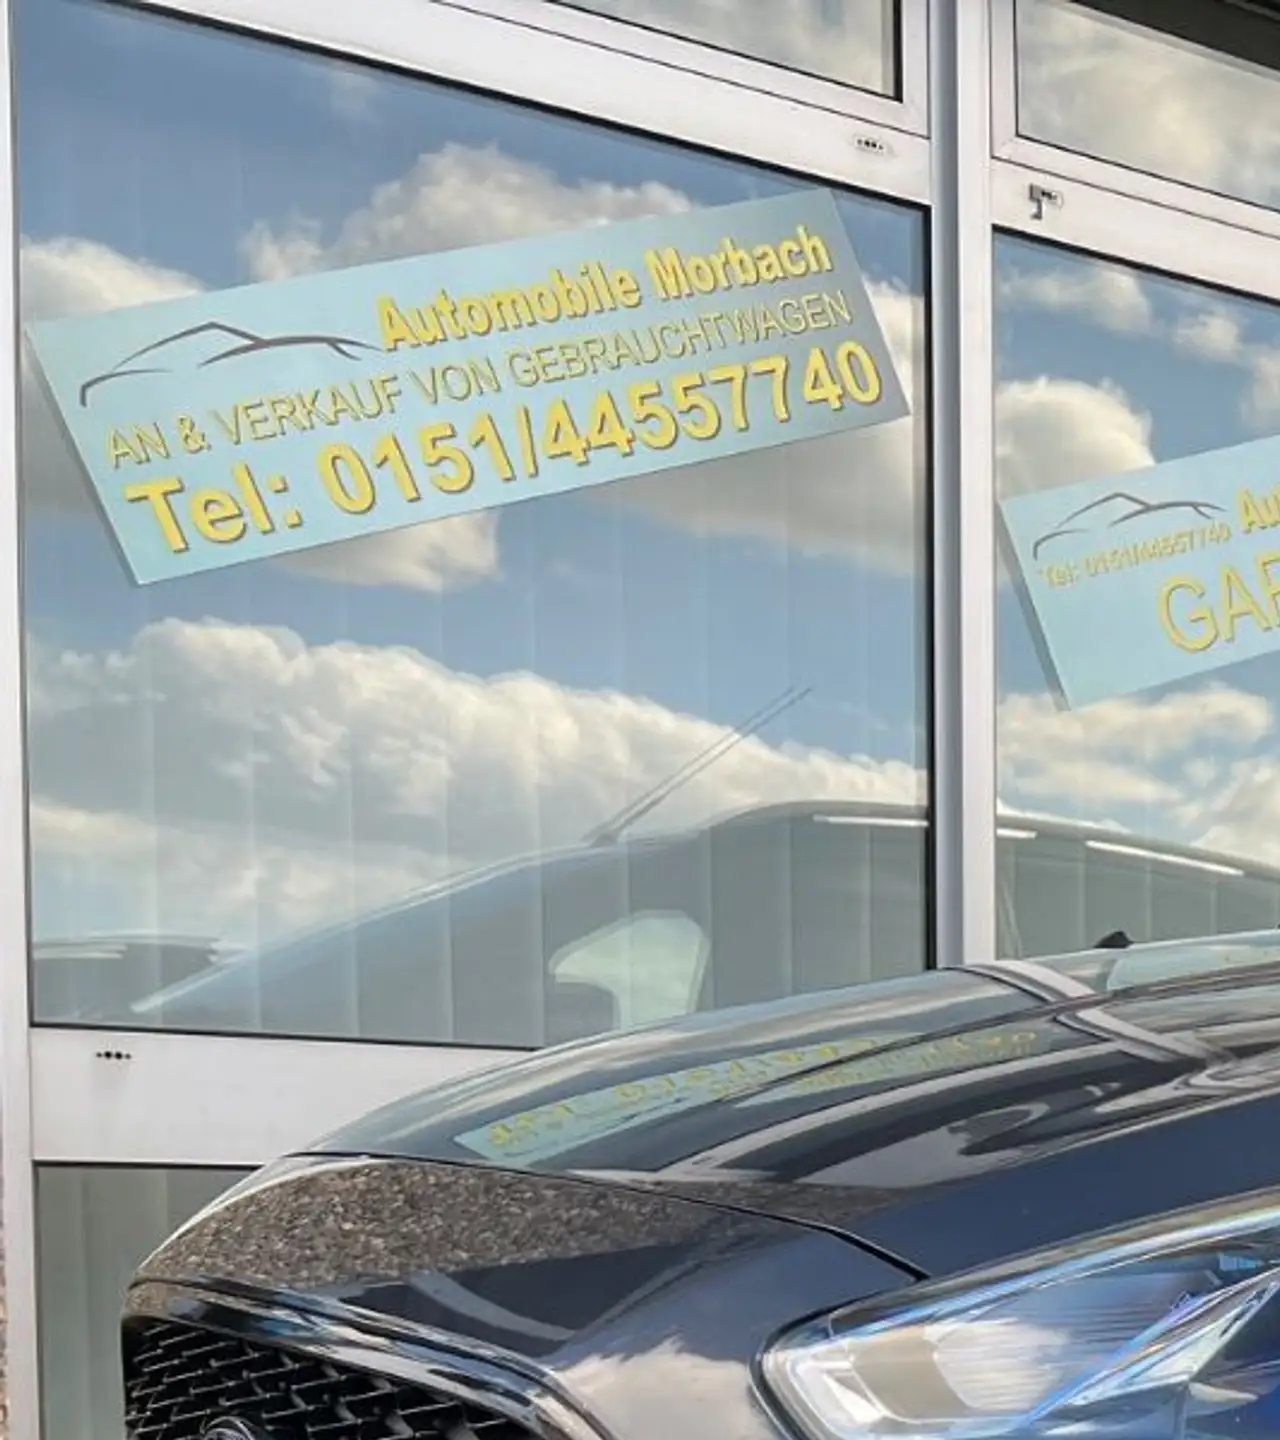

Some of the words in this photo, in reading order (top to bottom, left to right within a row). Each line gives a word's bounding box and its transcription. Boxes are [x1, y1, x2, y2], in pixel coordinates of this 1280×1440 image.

[376, 259, 643, 351] Automobile
[644, 225, 834, 301] Morbach
[108, 421, 170, 469] AN
[175, 414, 212, 455] &
[212, 374, 403, 445] VERKAUF
[409, 355, 501, 406] VON
[508, 289, 854, 388] GEBRAUCHTWAGEN
[124, 460, 304, 553] Tel:
[316, 339, 883, 516] 0151/44557740
